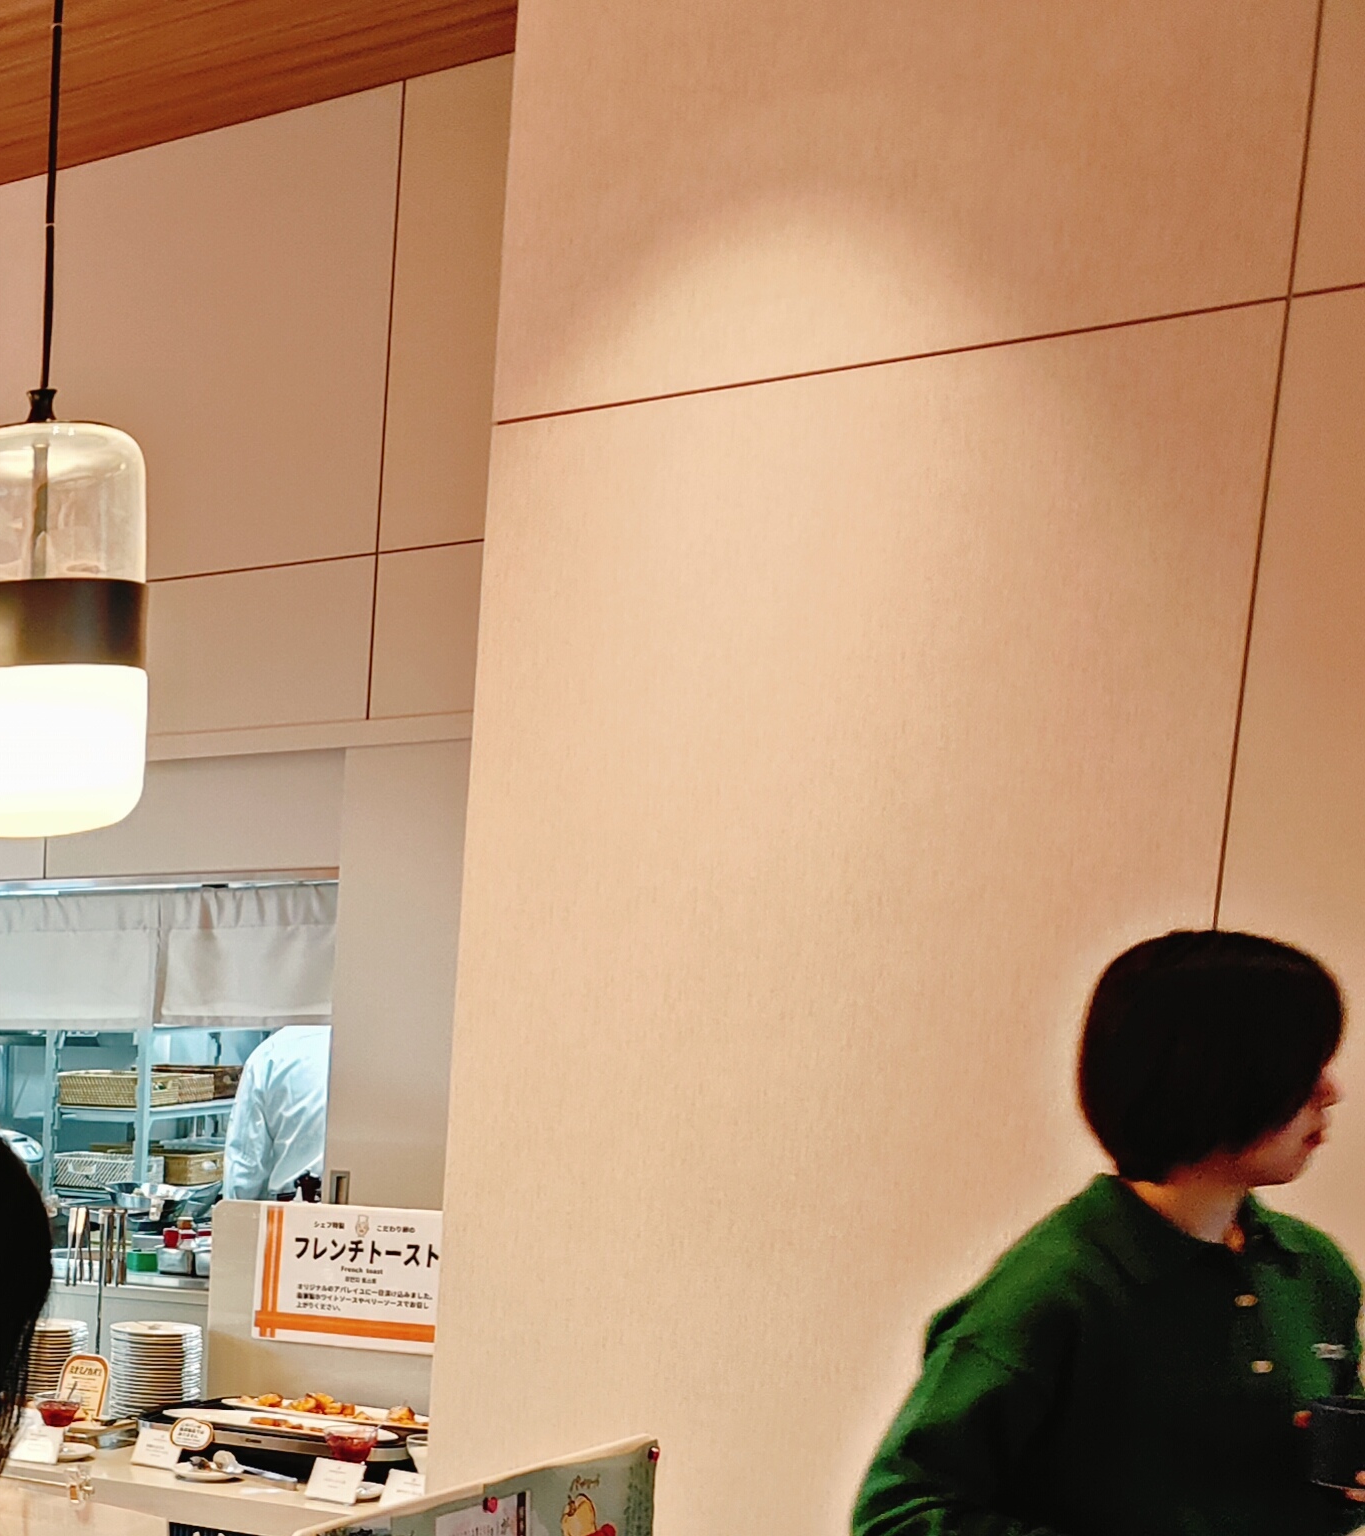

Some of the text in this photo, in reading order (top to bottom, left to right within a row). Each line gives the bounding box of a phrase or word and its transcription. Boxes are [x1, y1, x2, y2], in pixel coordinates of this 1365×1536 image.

[294, 1237, 440, 1268] フレンチトースト
[340, 1265, 384, 1275] French toast
